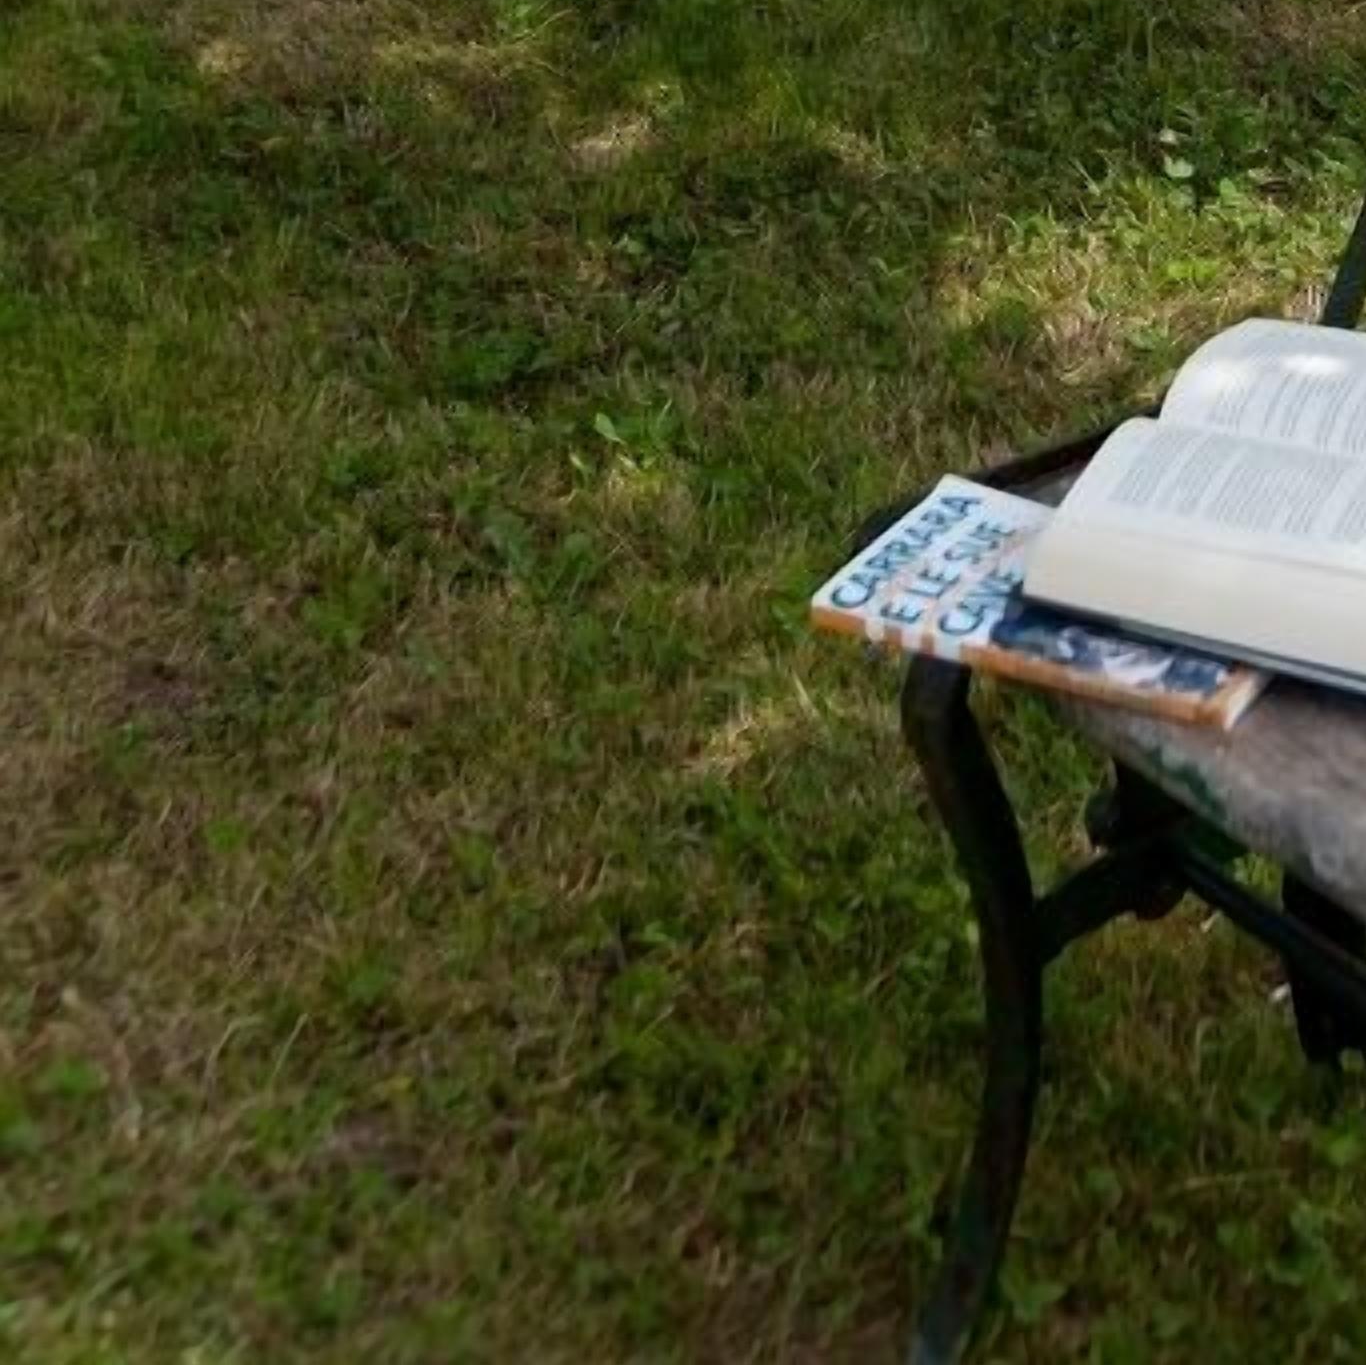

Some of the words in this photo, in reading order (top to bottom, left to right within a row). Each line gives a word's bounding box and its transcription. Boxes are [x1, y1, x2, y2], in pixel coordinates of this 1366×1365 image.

[830, 496, 982, 608] CARRARA
[879, 602, 923, 625] E
[905, 567, 961, 598] LE
